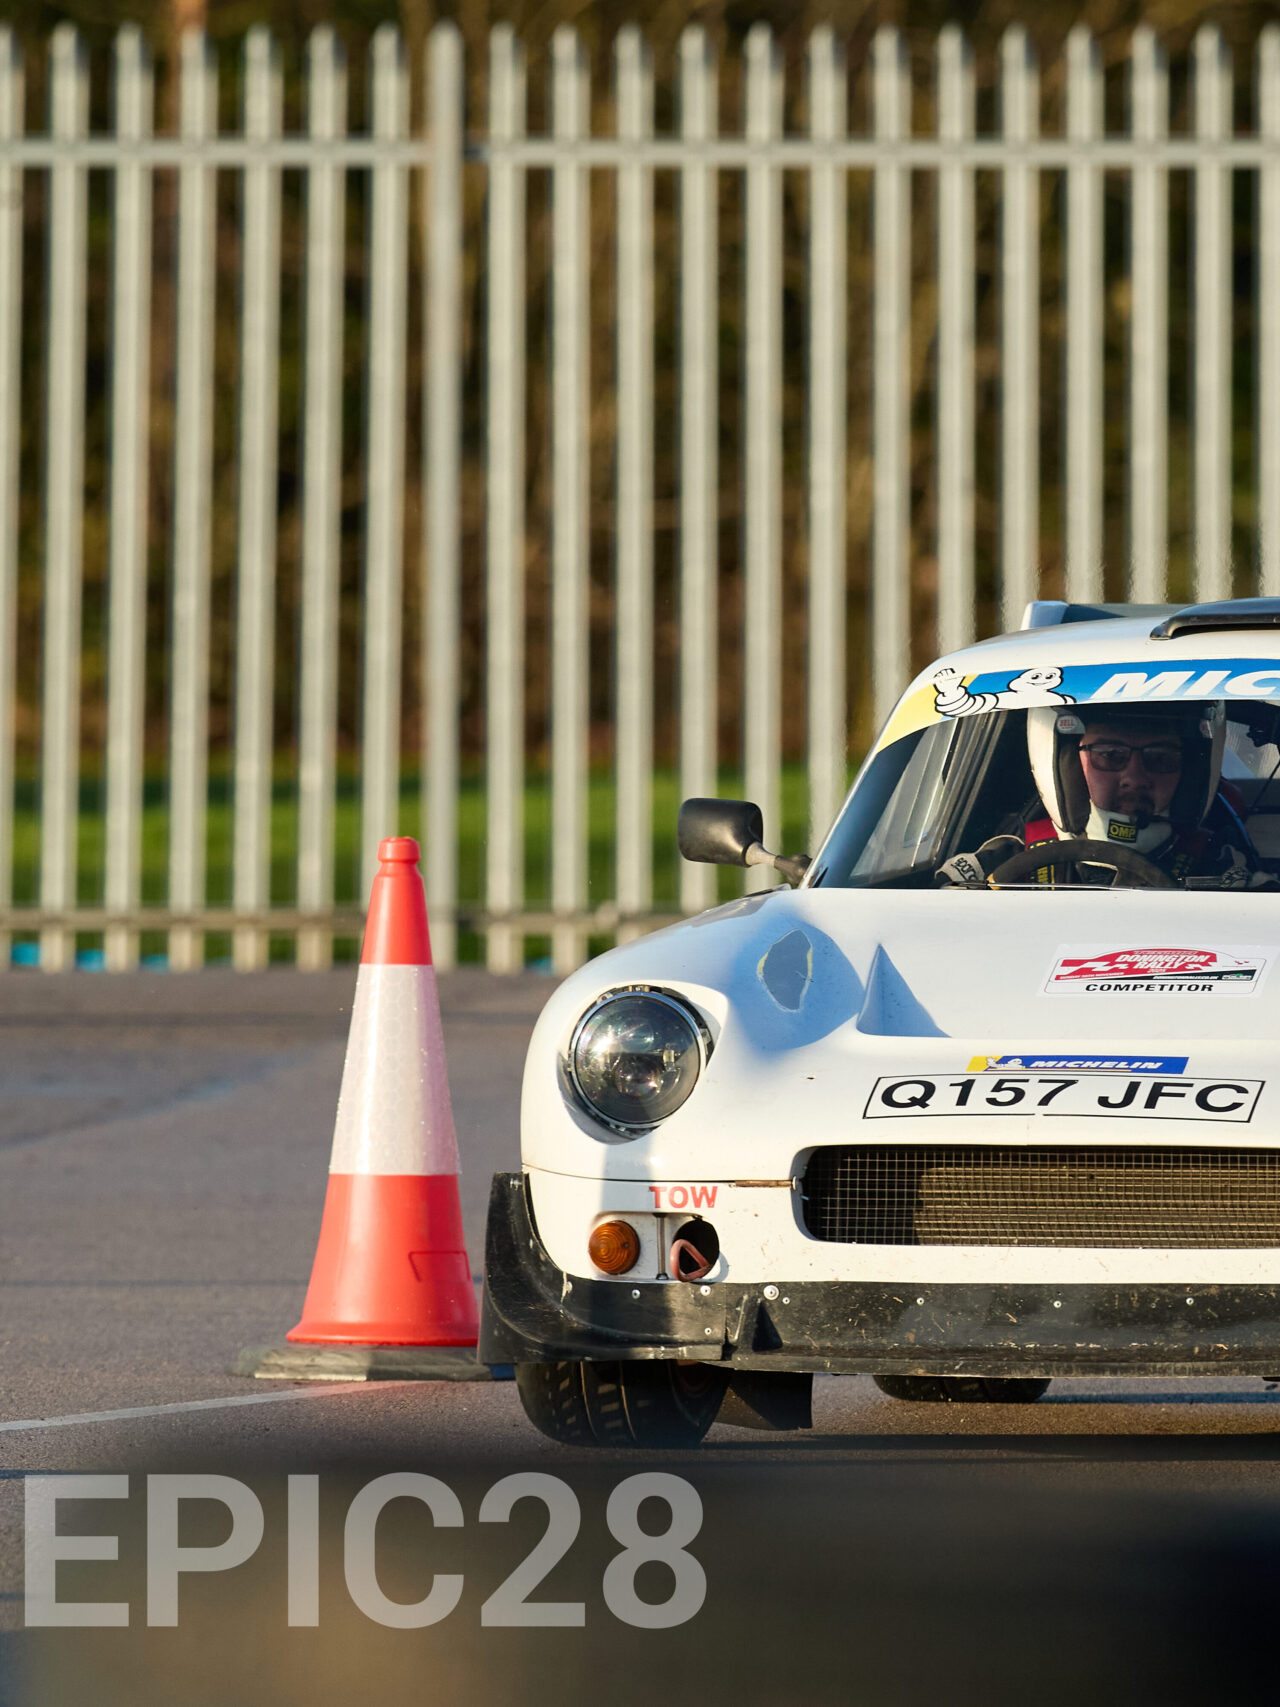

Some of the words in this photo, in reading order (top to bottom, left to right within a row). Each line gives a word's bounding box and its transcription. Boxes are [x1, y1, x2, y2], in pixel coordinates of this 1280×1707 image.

[1110, 824, 1136, 838] OMP
[1115, 954, 1211, 963] DONINGTON
[1132, 961, 1188, 969] RALLY
[1085, 983, 1214, 992] COMPETITOR
[1029, 1060, 1164, 1070] MICHELIN
[880, 1078, 1079, 1109] Q157
[1097, 1079, 1250, 1113] JFC
[649, 1185, 718, 1209] TOW
